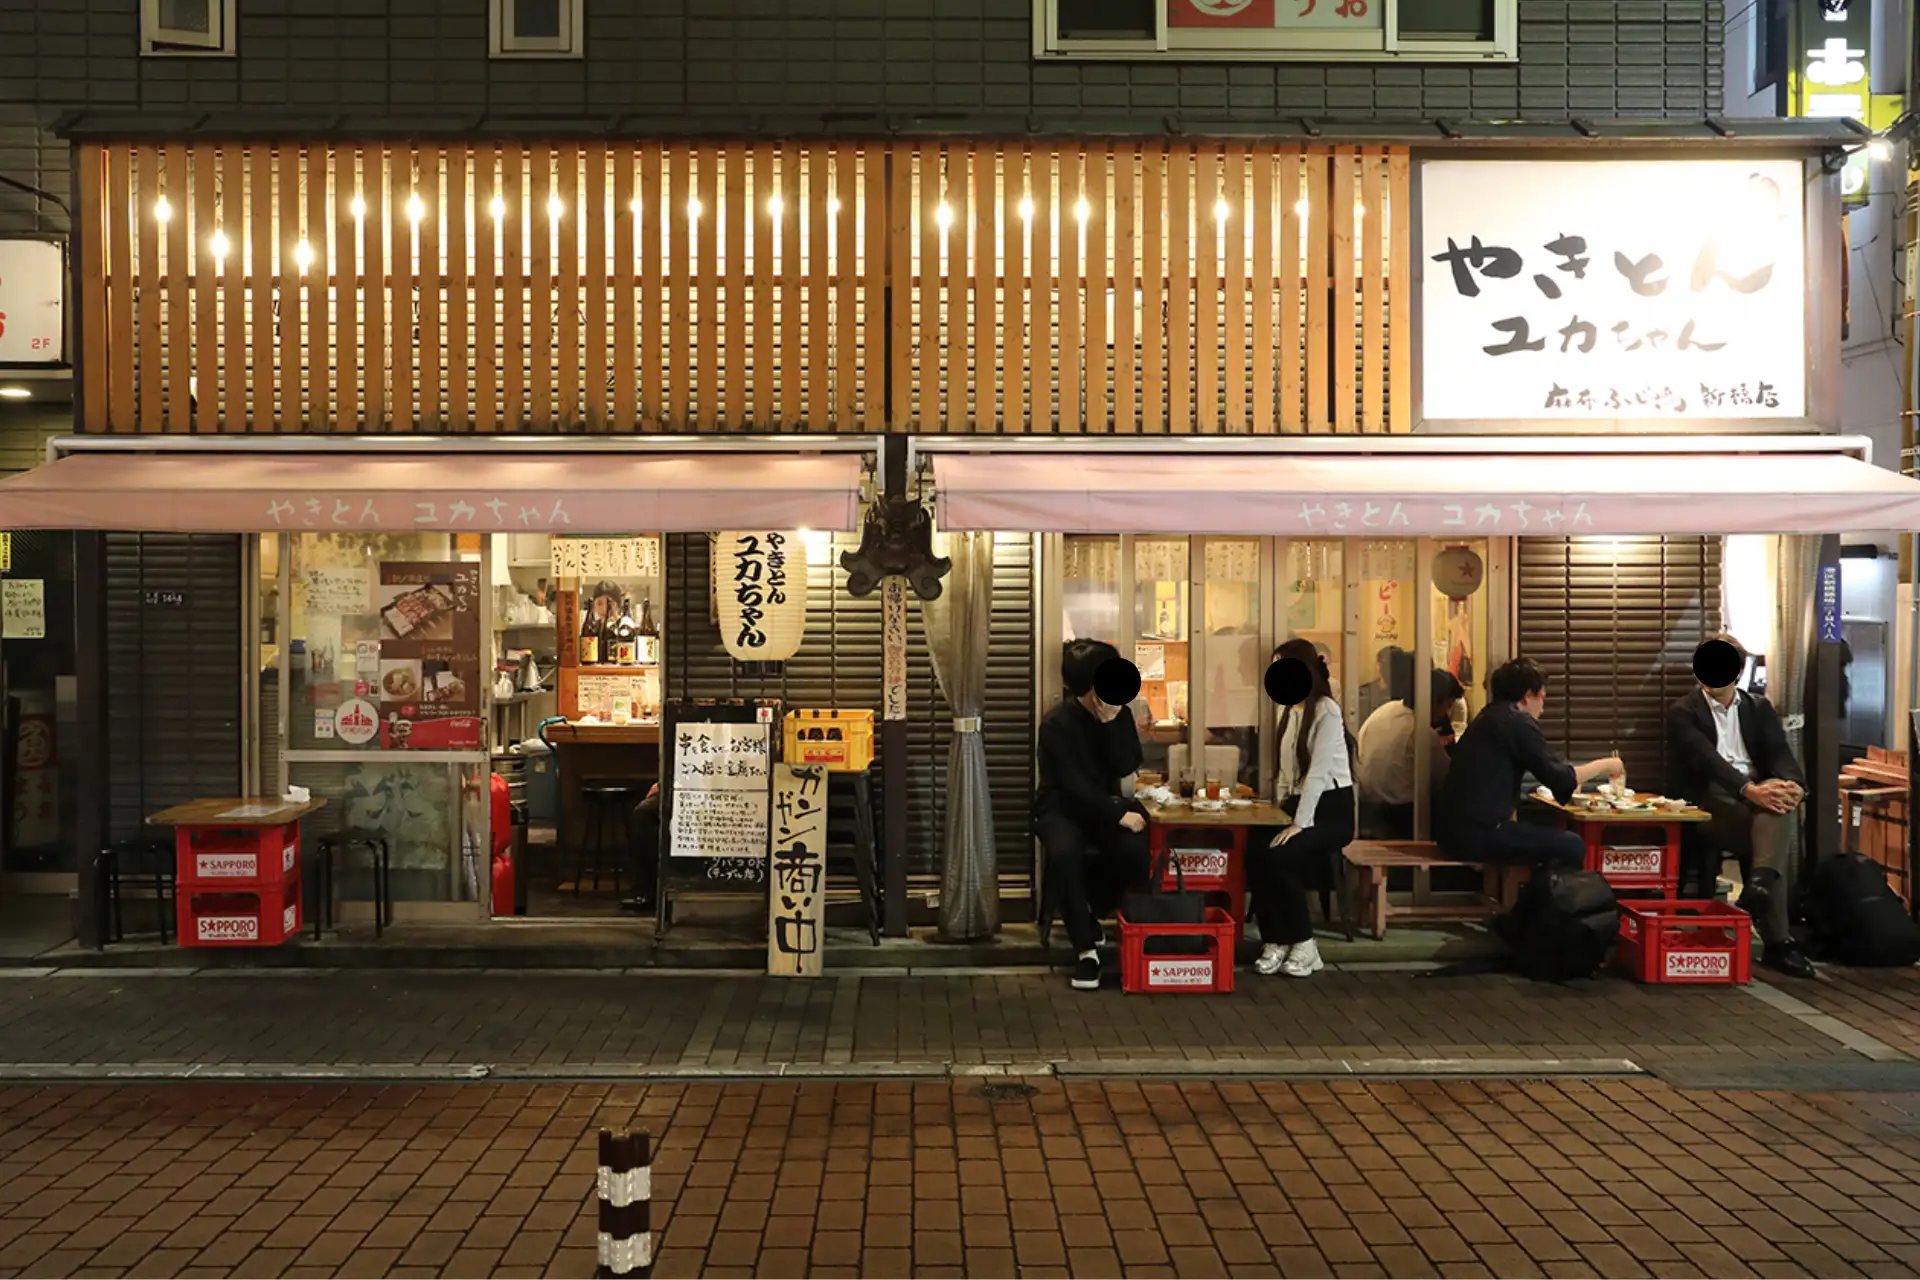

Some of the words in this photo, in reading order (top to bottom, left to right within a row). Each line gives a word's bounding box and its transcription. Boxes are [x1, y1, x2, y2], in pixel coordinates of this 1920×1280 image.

[1431, 233, 1775, 300] やきとん
[31, 338, 51, 349] 2F
[1482, 315, 1729, 357] ユカちゃん
[265, 498, 381, 525] やきとん
[1297, 501, 1411, 529] やきとん
[765, 531, 787, 605] やきとん
[733, 535, 767, 648] ユカちゃん
[209, 861, 256, 870] SAPPORO
[1162, 966, 1211, 978] SAPPORO
